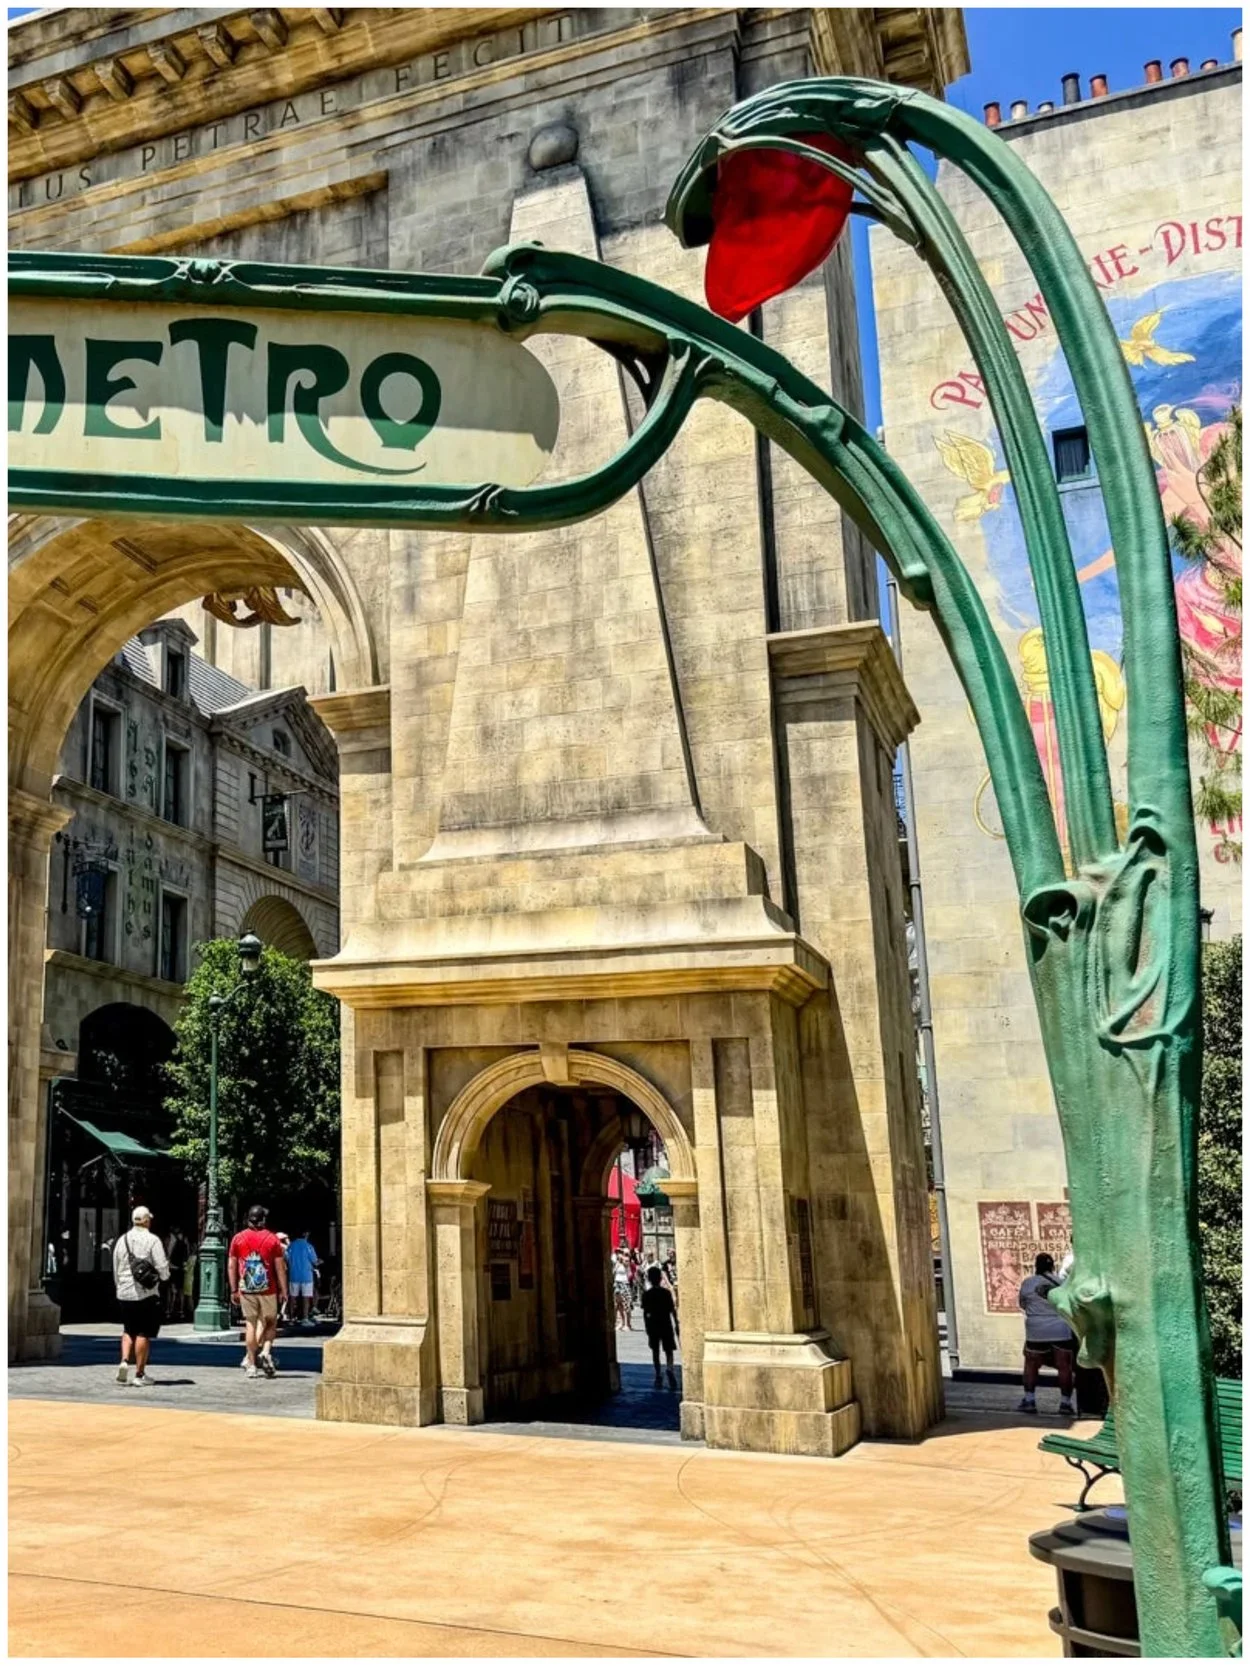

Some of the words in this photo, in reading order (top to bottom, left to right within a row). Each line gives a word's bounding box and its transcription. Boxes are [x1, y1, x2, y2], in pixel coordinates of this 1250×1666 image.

[141, 90, 338, 171] PETRAE
[395, 14, 574, 92] FECIT
[8, 317, 442, 476] METRO
